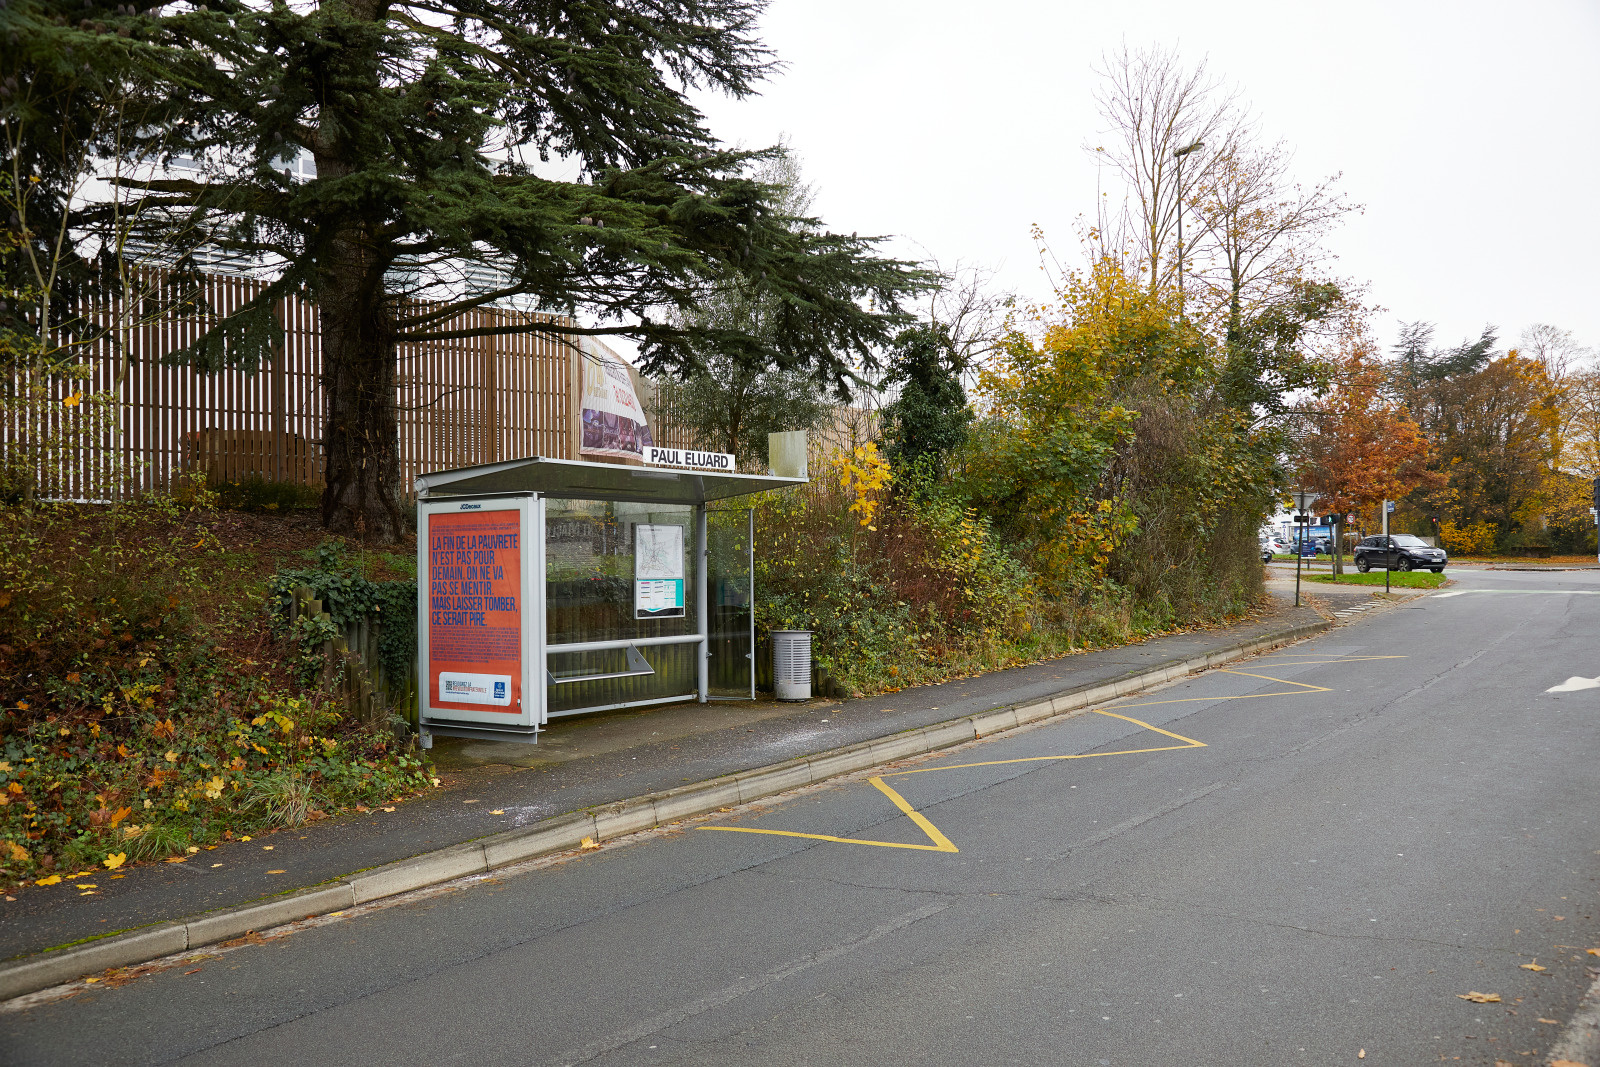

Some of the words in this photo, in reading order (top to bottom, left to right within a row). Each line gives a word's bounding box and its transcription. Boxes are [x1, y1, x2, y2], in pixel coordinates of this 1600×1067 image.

[651, 449, 681, 465] PAUL
[685, 452, 728, 468] ELUARD
[432, 536, 442, 550] LA
[442, 536, 454, 550] FIN
[456, 536, 466, 550] DE
[467, 535, 477, 549] LA
[478, 533, 518, 549] PAUVRETÉ
[432, 551, 454, 565] N'EST
[456, 551, 472, 565] PAS
[473, 550, 495, 565] POUR
[432, 566, 465, 580] DEMAIN.
[466, 566, 478, 580] ON
[480, 566, 490, 580] NE
[492, 566, 504, 580] VA
[432, 581, 447, 595] PAS
[449, 581, 459, 595] SE
[461, 581, 494, 595] MENTIR.
[432, 596, 451, 610] MAIS
[453, 596, 482, 611] LAISSER
[484, 597, 518, 612] TOMBER,
[432, 611, 442, 625] CE
[443, 612, 468, 626] SERAIT
[469, 612, 487, 626] PIRE.
